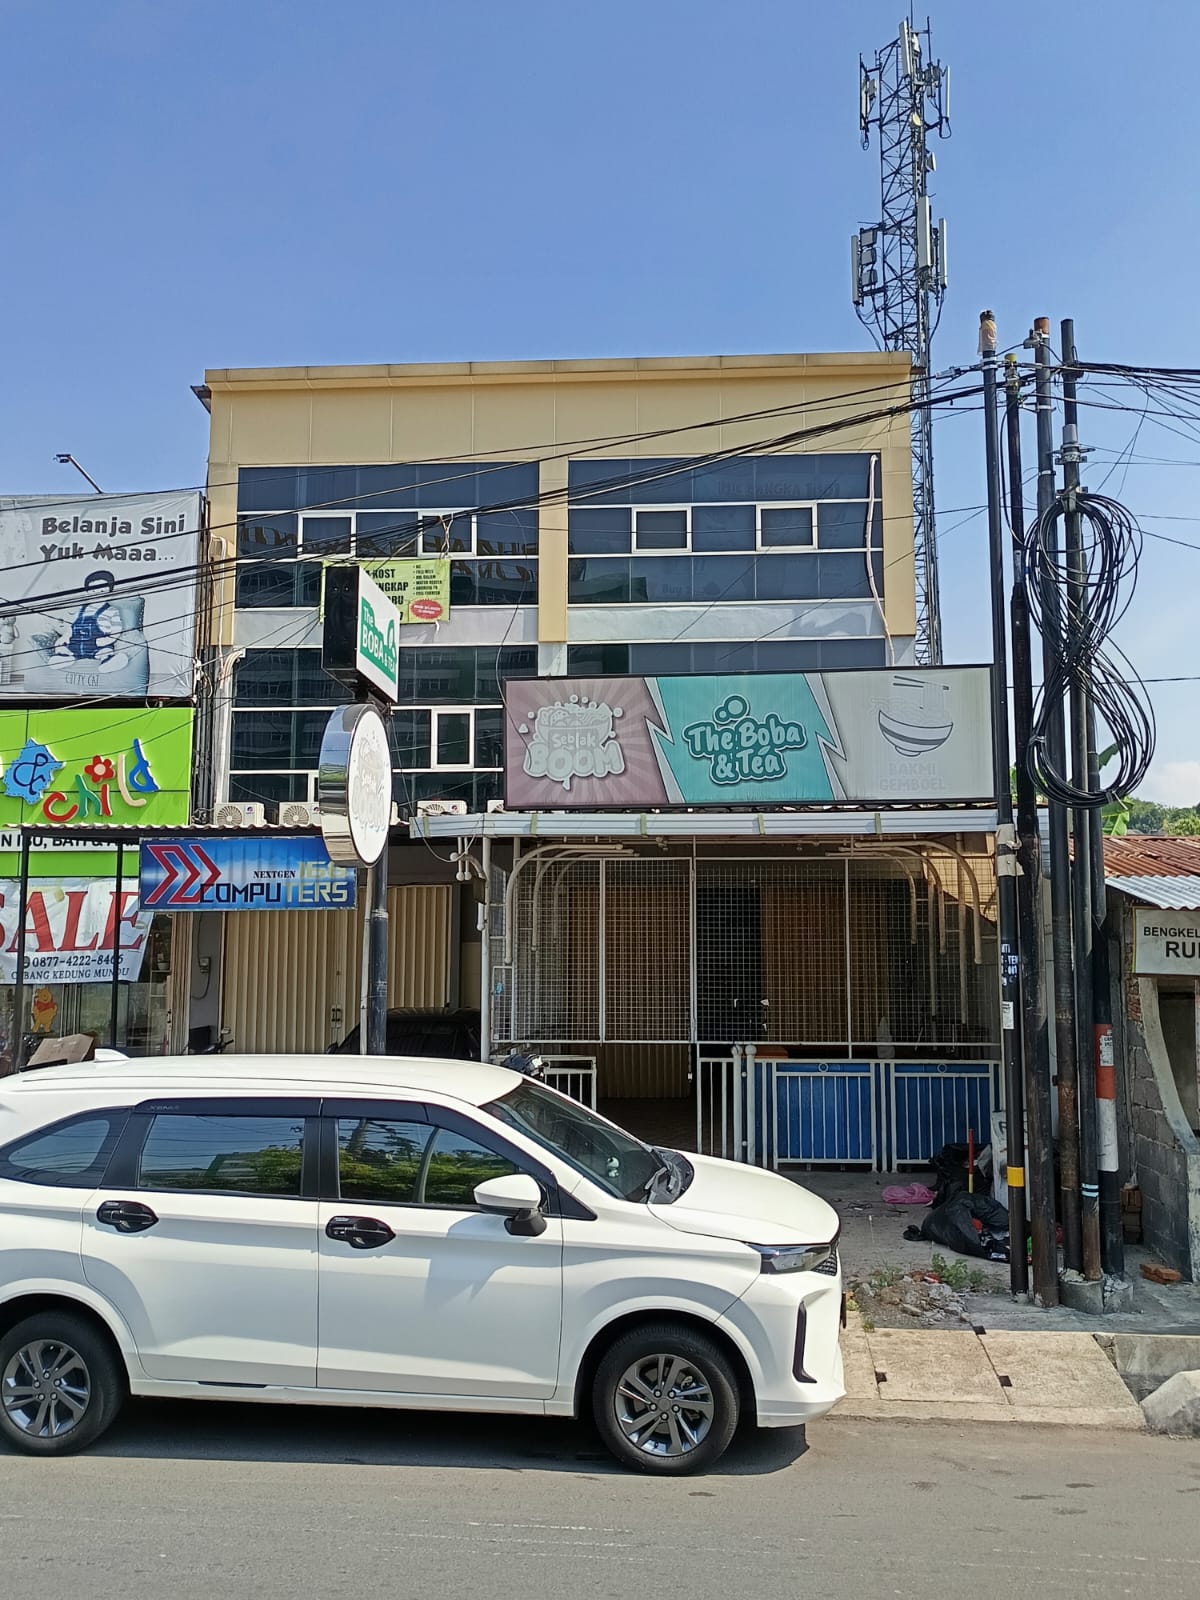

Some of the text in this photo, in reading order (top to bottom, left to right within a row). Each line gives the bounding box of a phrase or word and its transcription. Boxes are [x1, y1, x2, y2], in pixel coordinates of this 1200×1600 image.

[42, 514, 185, 537] Belanja Sini
[40, 542, 174, 561] Yuk Maaa...
[372, 569, 395, 579] KOST
[376, 582, 408, 592] NGKAP
[387, 595, 404, 605] RU
[363, 606, 374, 627] The
[362, 624, 384, 663] BOBA
[552, 732, 596, 748] Seblak
[688, 718, 801, 752] The Boba
[525, 741, 624, 778] BOOM
[715, 754, 735, 778] &
[889, 763, 936, 776] BAKMI
[880, 778, 946, 791] GEMBOEL
[17, 834, 47, 848] IU,
[253, 870, 296, 879] NEXTGEN
[199, 882, 348, 903] COMPUTERS
[0, 891, 144, 952] ALE
[1144, 927, 1200, 938] BENGKEL
[1165, 941, 1200, 958] RU
[11, 970, 50, 980] CBANG
[52, 970, 91, 979] KEDUNG
